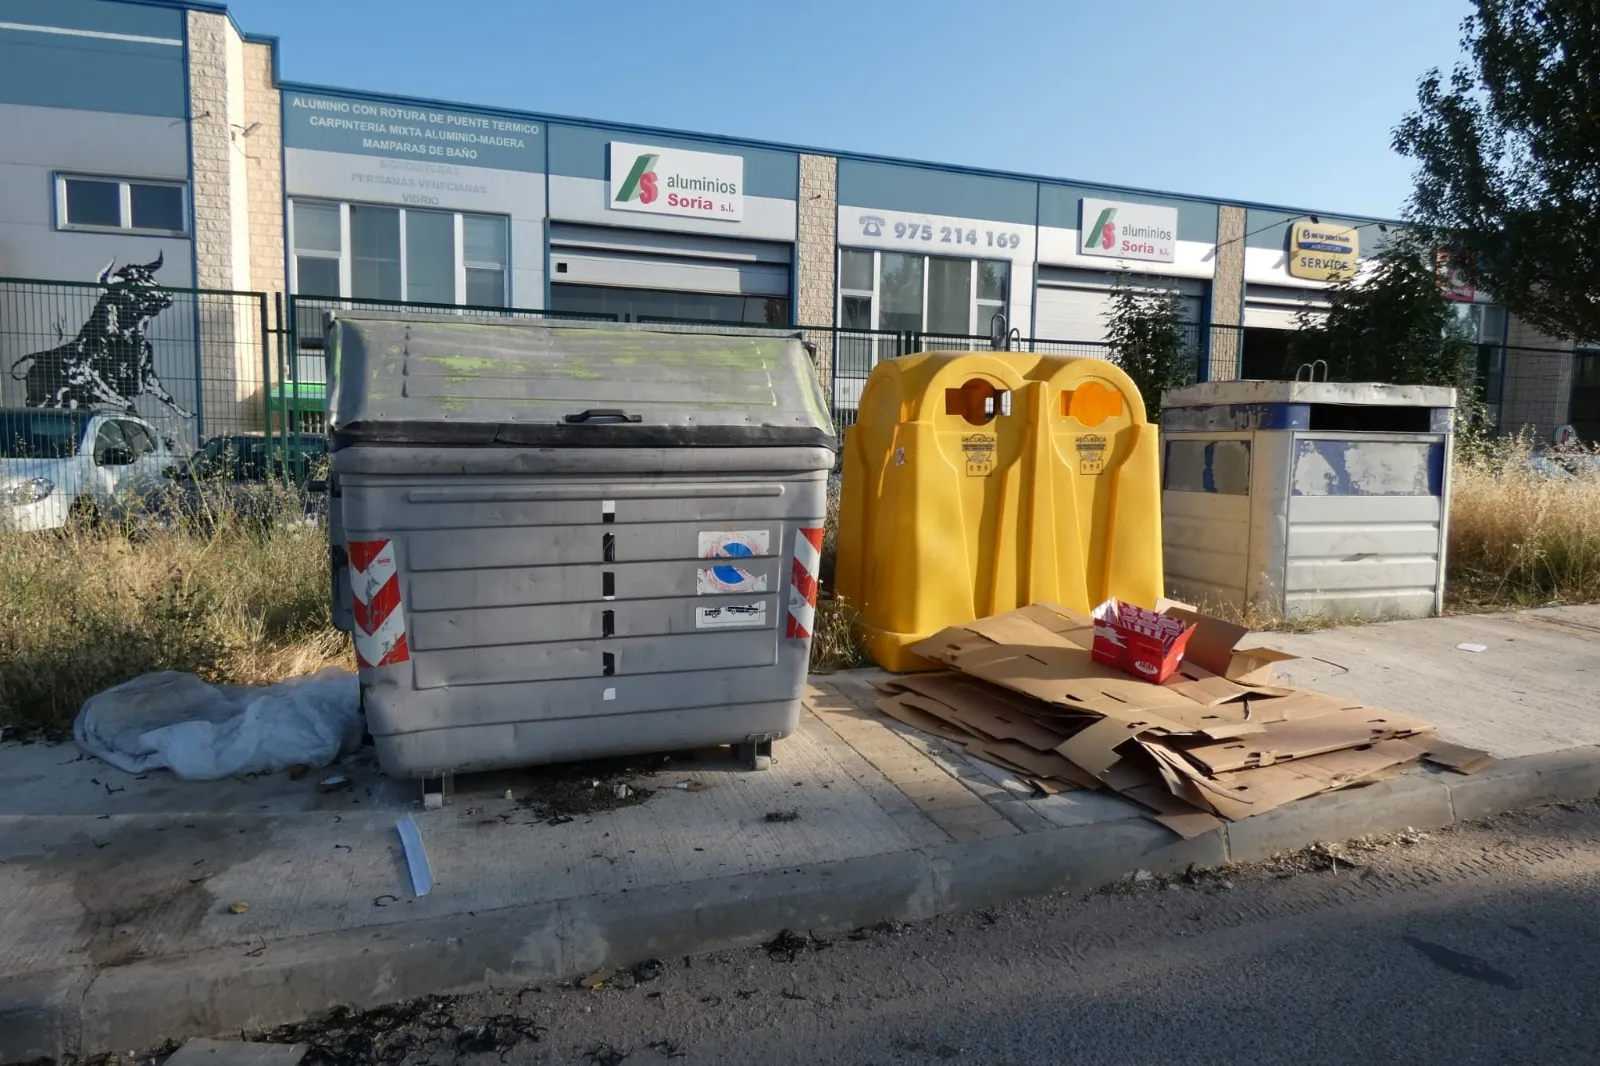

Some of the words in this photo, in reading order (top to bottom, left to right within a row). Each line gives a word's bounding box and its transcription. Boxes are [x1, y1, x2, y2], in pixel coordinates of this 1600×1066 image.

[293, 98, 350, 113] ALUMINIO
[352, 104, 378, 116] CON
[380, 107, 427, 123] ROTURA
[430, 113, 445, 124] DE
[447, 116, 490, 129] PUENTE
[492, 120, 539, 135] TERMICO
[310, 116, 387, 134] CARPINTERIA
[389, 125, 423, 138] MIXTA
[425, 128, 525, 149] ALUMINIO-MADERA
[363, 138, 426, 155] MAMPARAS
[429, 145, 444, 156] DE
[446, 145, 478, 160] BAÑO
[351, 173, 416, 189] PERSIANAS
[418, 179, 487, 195] VENECIANAS
[667, 173, 736, 195] aluminios
[401, 193, 440, 206] VIDRIO
[667, 193, 713, 210] Soria
[720, 203, 735, 213] s.l.
[894, 221, 933, 242] 975
[940, 226, 978, 246] 214
[986, 230, 1020, 250] 169
[1122, 222, 1172, 241] aluminios
[1122, 240, 1154, 255] Soria
[1300, 256, 1349, 271] SERVICE
